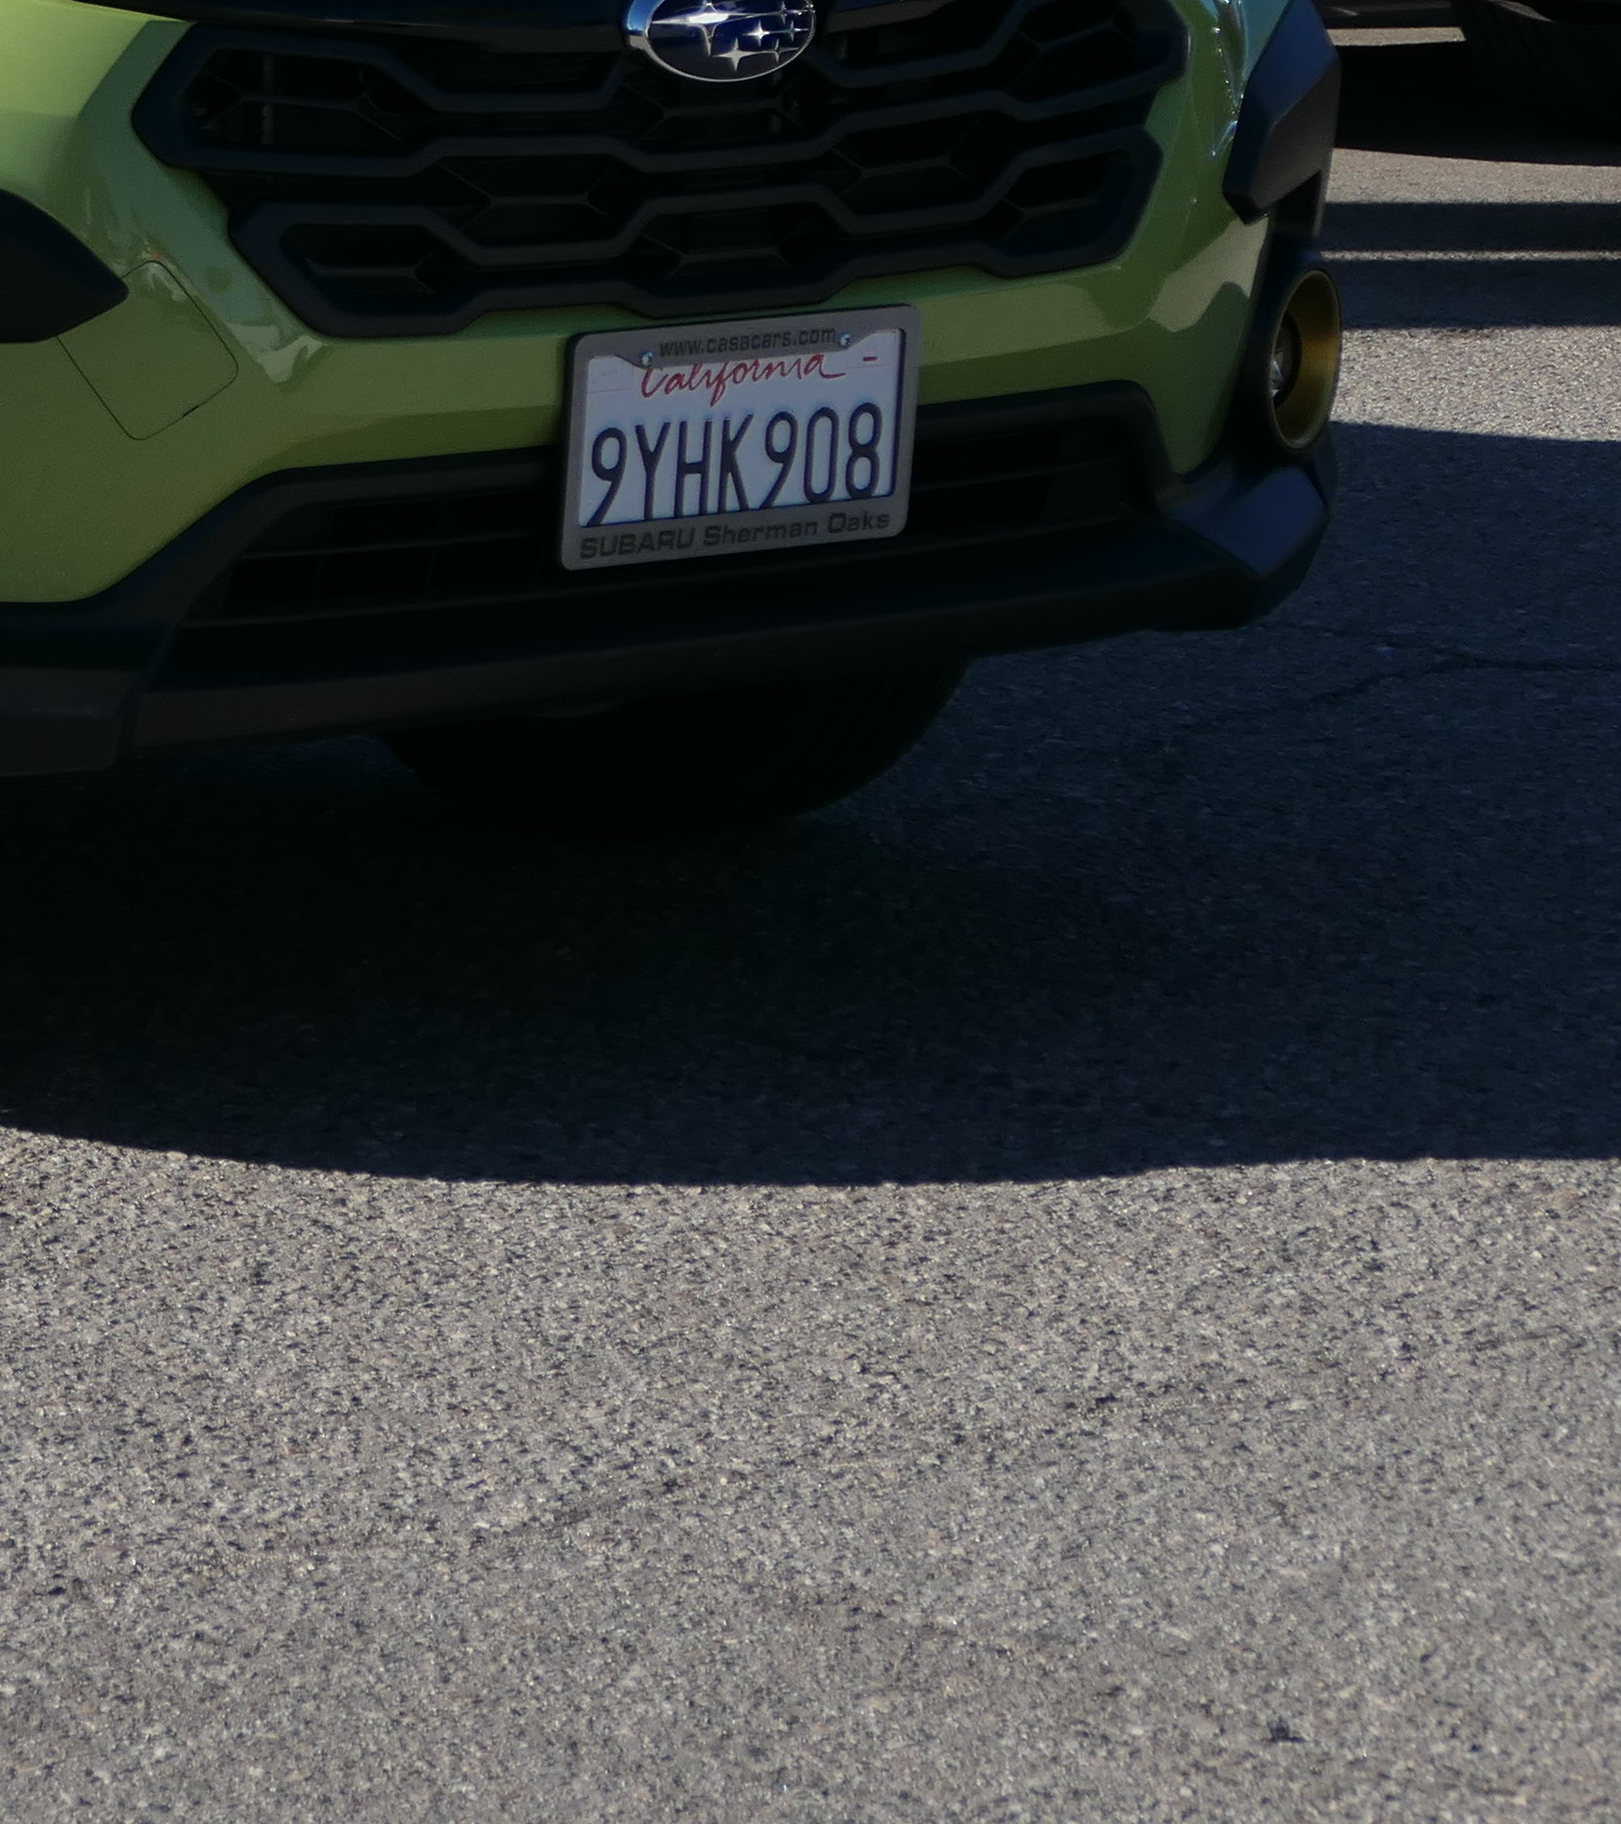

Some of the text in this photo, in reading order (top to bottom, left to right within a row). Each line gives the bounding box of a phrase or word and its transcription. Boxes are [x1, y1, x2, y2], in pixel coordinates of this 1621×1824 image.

[659, 327, 837, 359] www.casacars.com
[641, 353, 845, 407] California
[585, 402, 883, 528] 9YHK908
[579, 510, 891, 560] SUBARU Sherman Oaks
